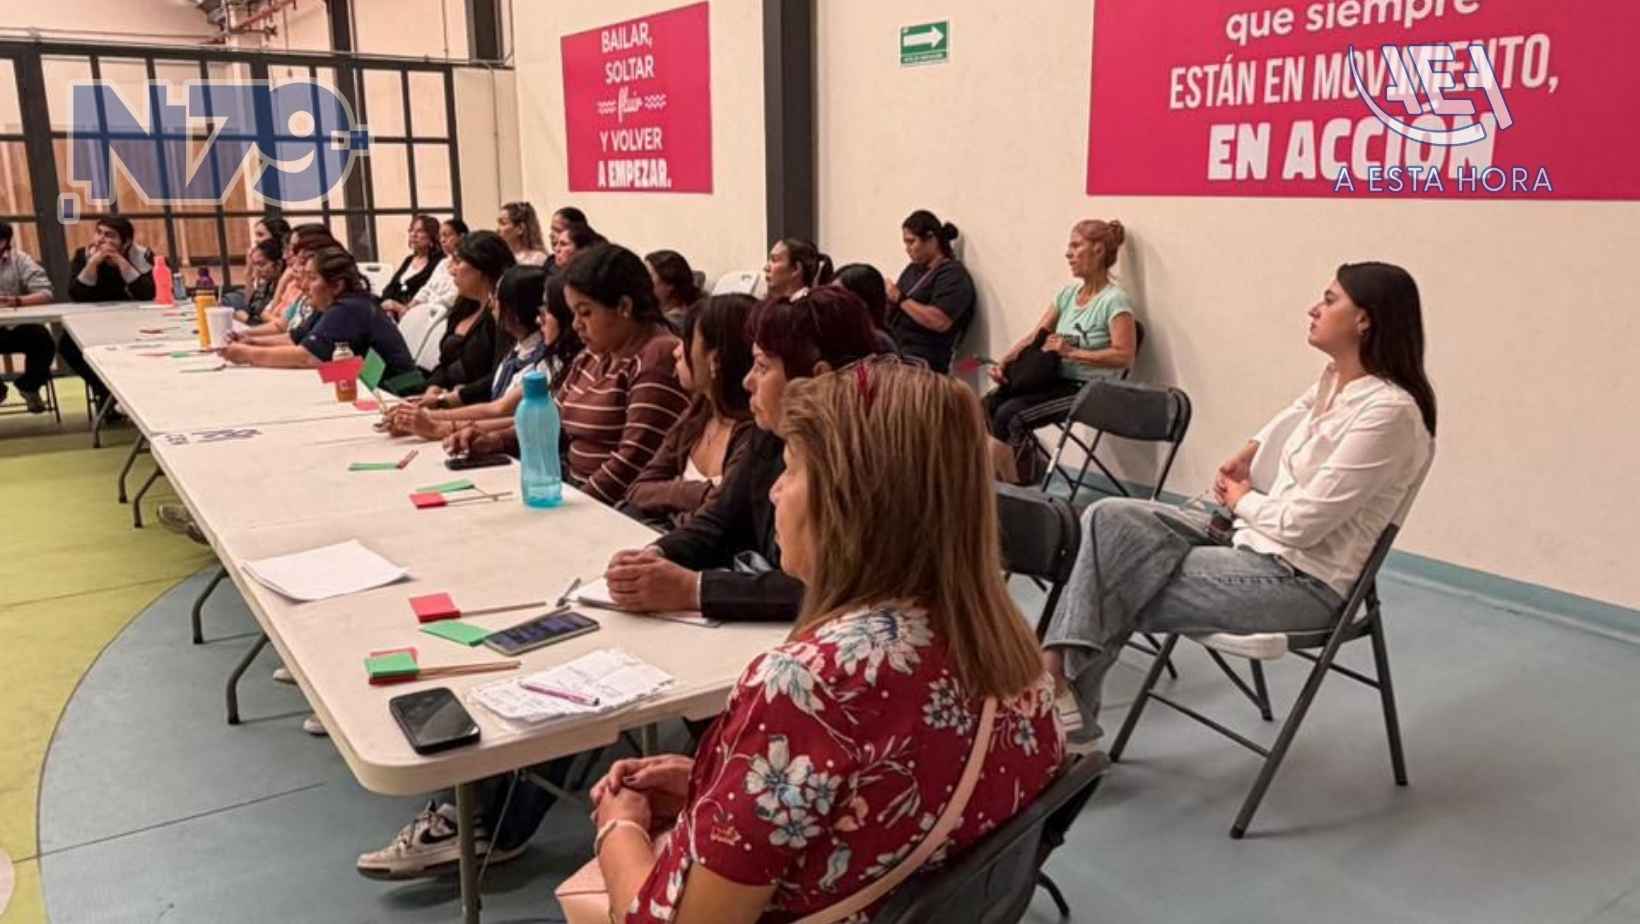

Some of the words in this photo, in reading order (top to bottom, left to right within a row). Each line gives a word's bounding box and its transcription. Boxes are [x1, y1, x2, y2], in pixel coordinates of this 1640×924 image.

[601, 22, 653, 53] BAILAR,
[1226, 8, 1294, 46] que
[605, 55, 655, 84] SOLTAR
[1169, 54, 1257, 109] ESTÁN
[1264, 56, 1305, 104] EN
[600, 131, 609, 152] Y
[611, 127, 663, 152] VOLVER
[1207, 122, 1271, 181] EN
[1282, 103, 1497, 181] ACCIÓN
[597, 160, 606, 188] A
[608, 159, 672, 188] EMPEZAR.
